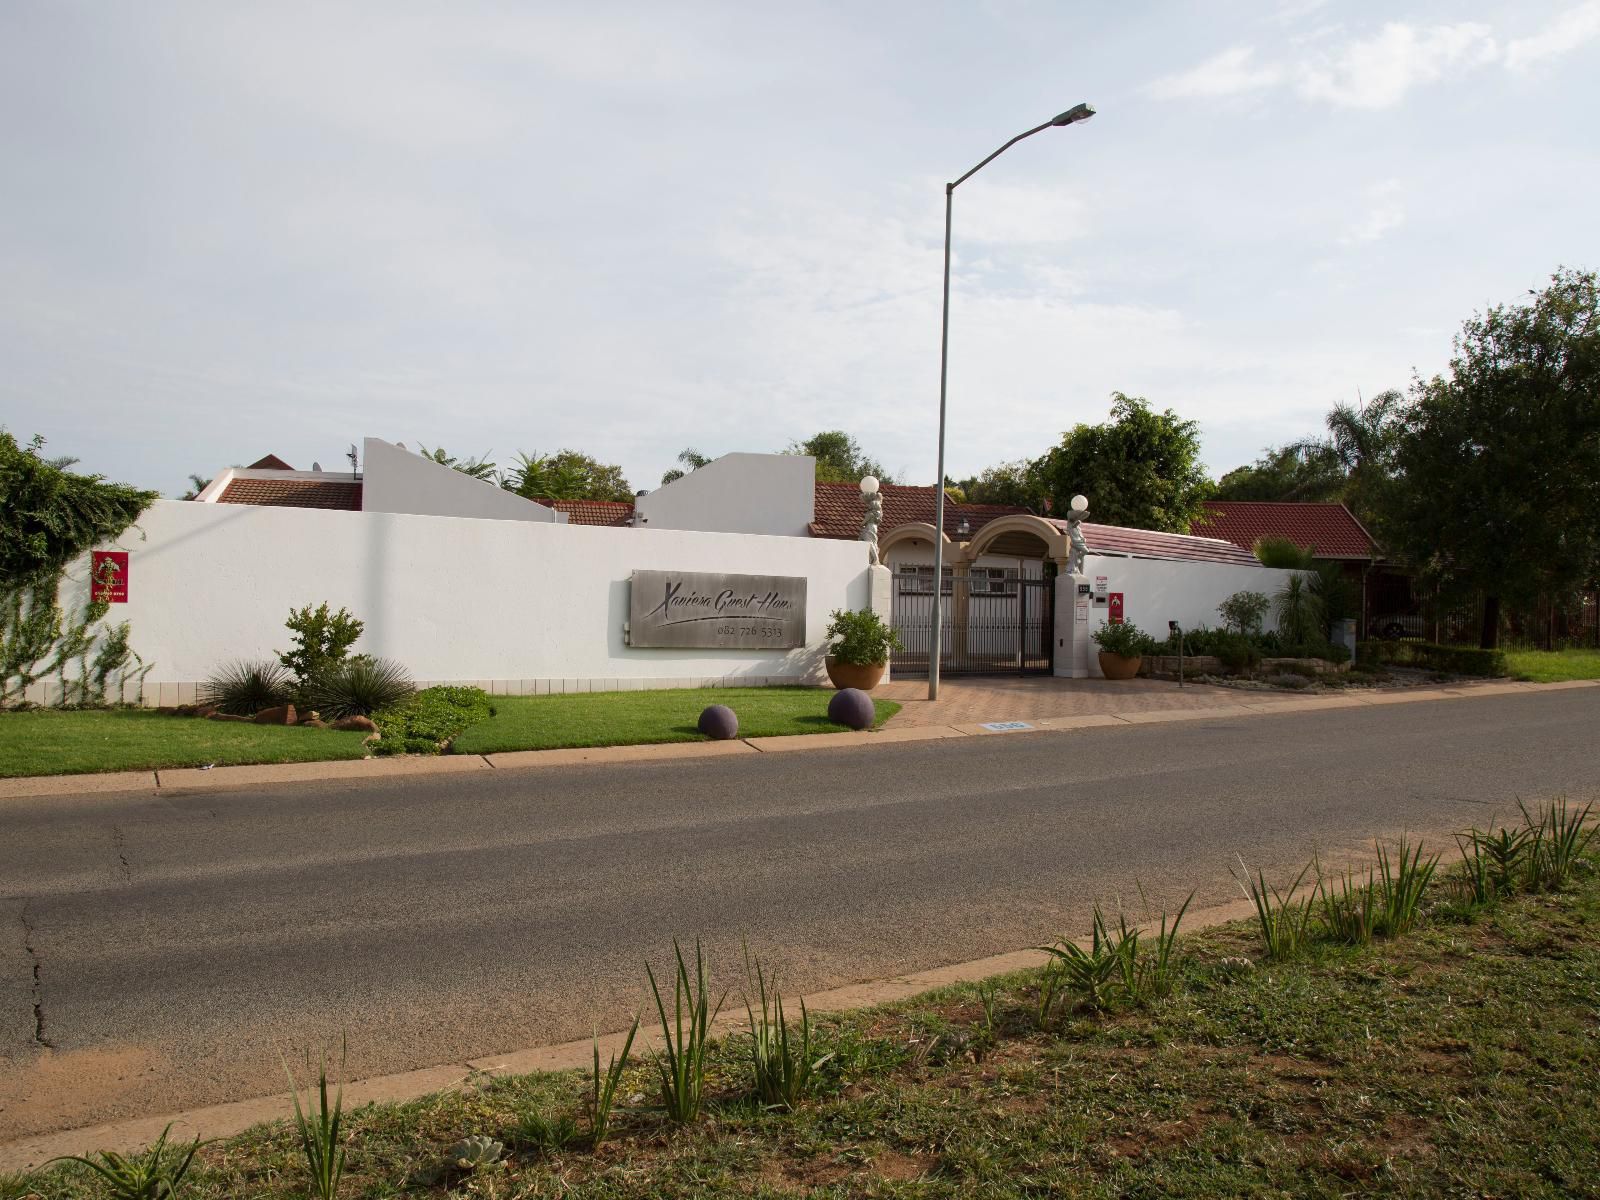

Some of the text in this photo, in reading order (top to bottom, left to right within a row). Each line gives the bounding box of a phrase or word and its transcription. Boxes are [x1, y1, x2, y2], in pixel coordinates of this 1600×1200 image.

[642, 577, 793, 620] Xaviera Guest Hou
[717, 625, 736, 635] 082
[740, 626, 757, 637] 726
